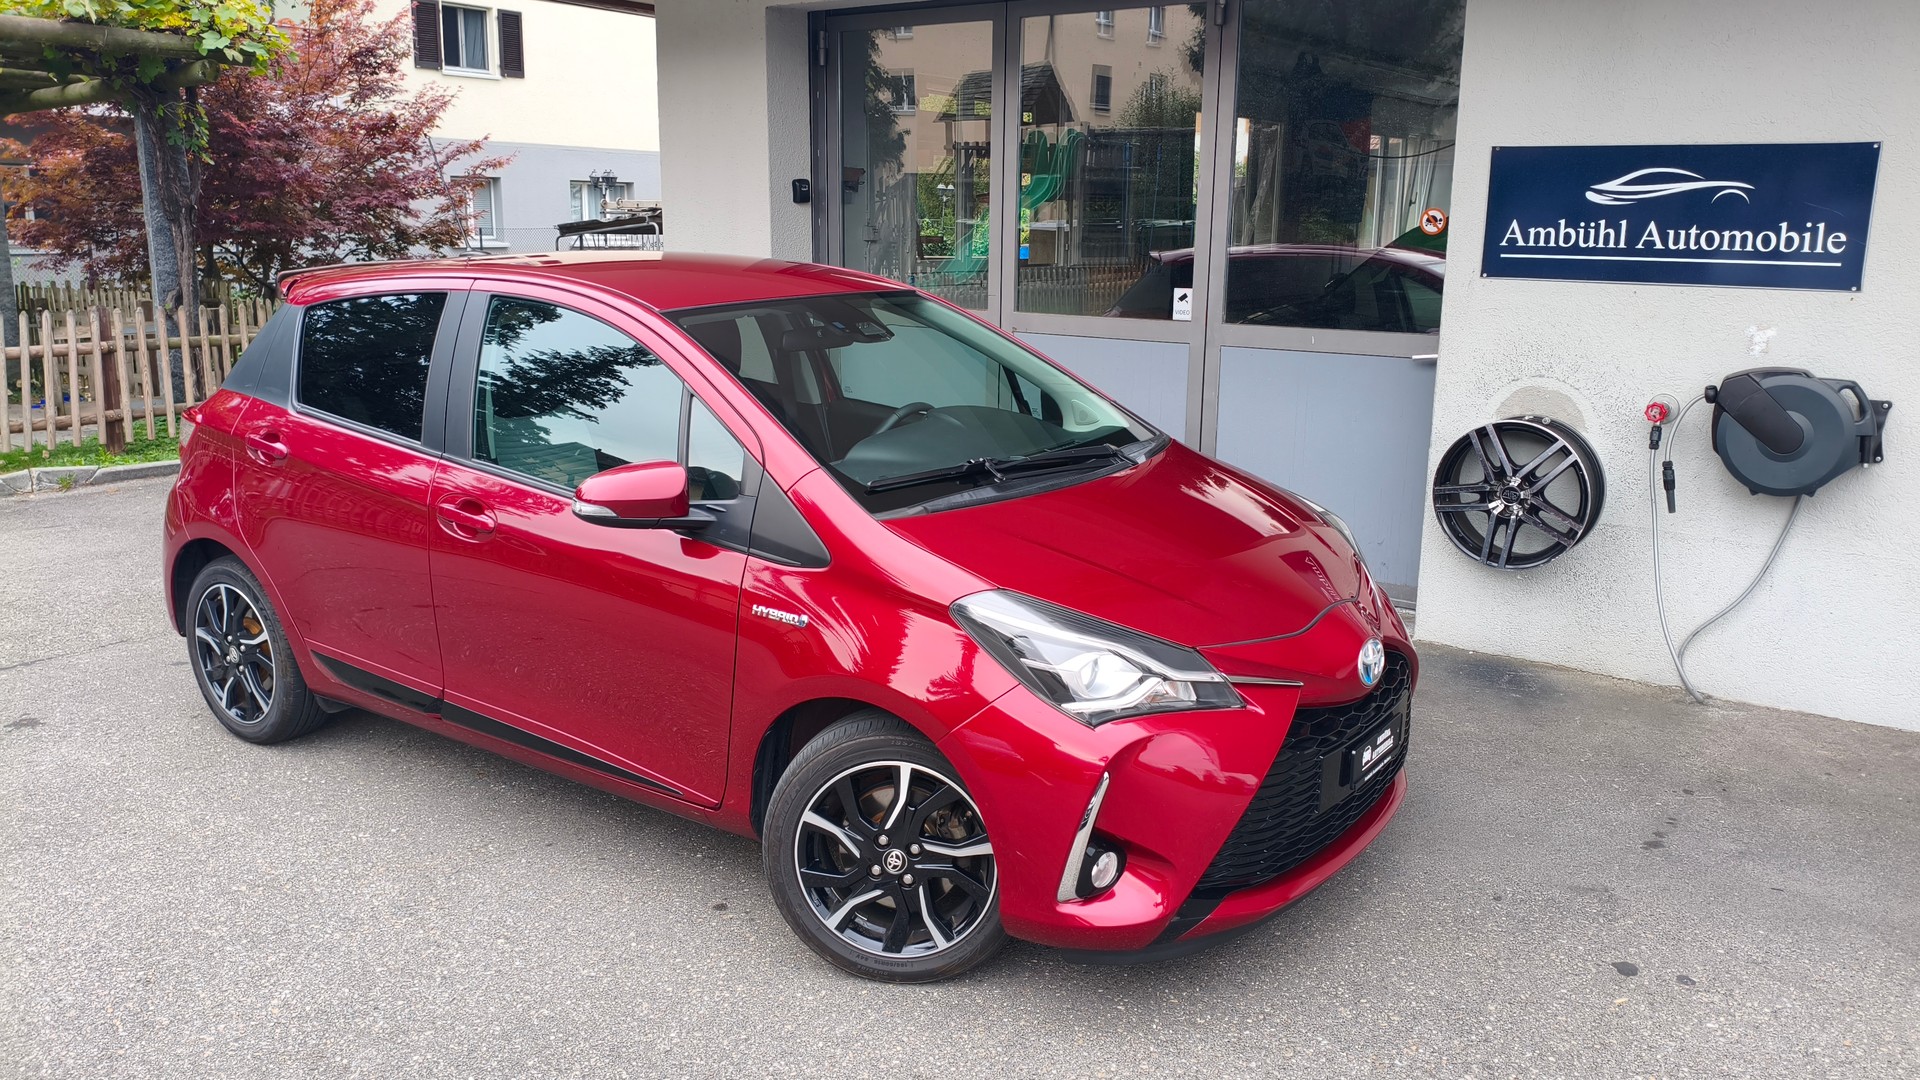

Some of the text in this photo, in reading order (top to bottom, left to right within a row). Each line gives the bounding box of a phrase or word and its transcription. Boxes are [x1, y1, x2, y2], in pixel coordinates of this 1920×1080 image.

[1500, 218, 1847, 254] Ambühl Automobile
[752, 604, 800, 626] HYBRID
